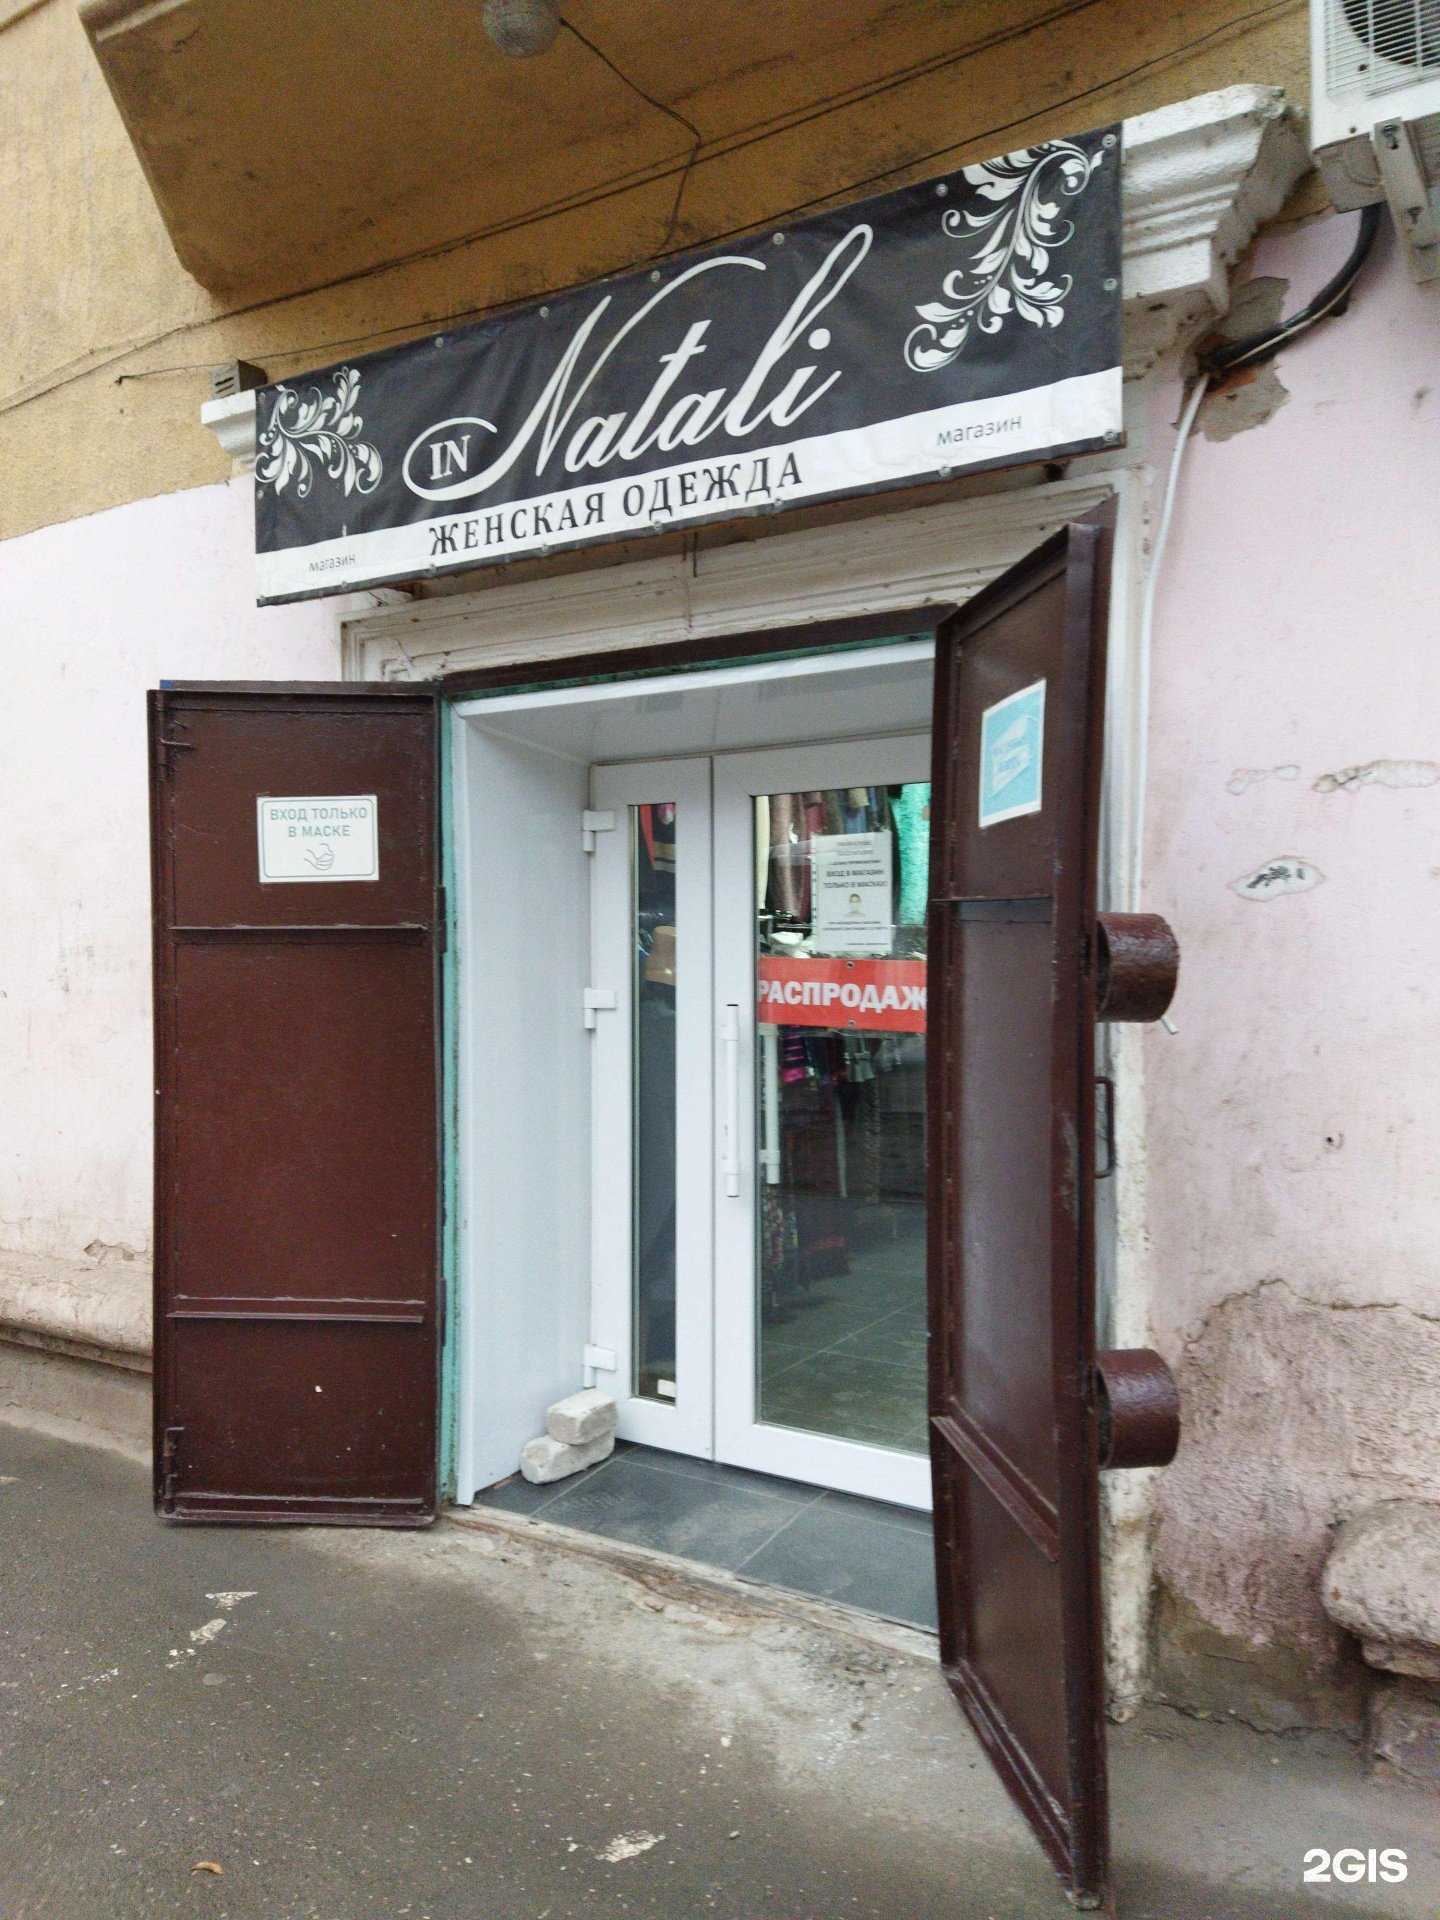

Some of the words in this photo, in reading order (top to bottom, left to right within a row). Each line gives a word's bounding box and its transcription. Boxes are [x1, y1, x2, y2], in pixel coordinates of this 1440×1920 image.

[403, 223, 874, 501] Natali
[936, 416, 1022, 446] магазин
[429, 435, 472, 481] IN
[429, 492, 605, 556] ЖЕНСКАЯ
[622, 451, 803, 517] ОДЕЖДА
[309, 554, 356, 573] магазин
[270, 808, 308, 821] ВХОД
[311, 807, 368, 819] ТОЛЬКО
[288, 826, 297, 838] В
[302, 825, 351, 837] МАСКЕ
